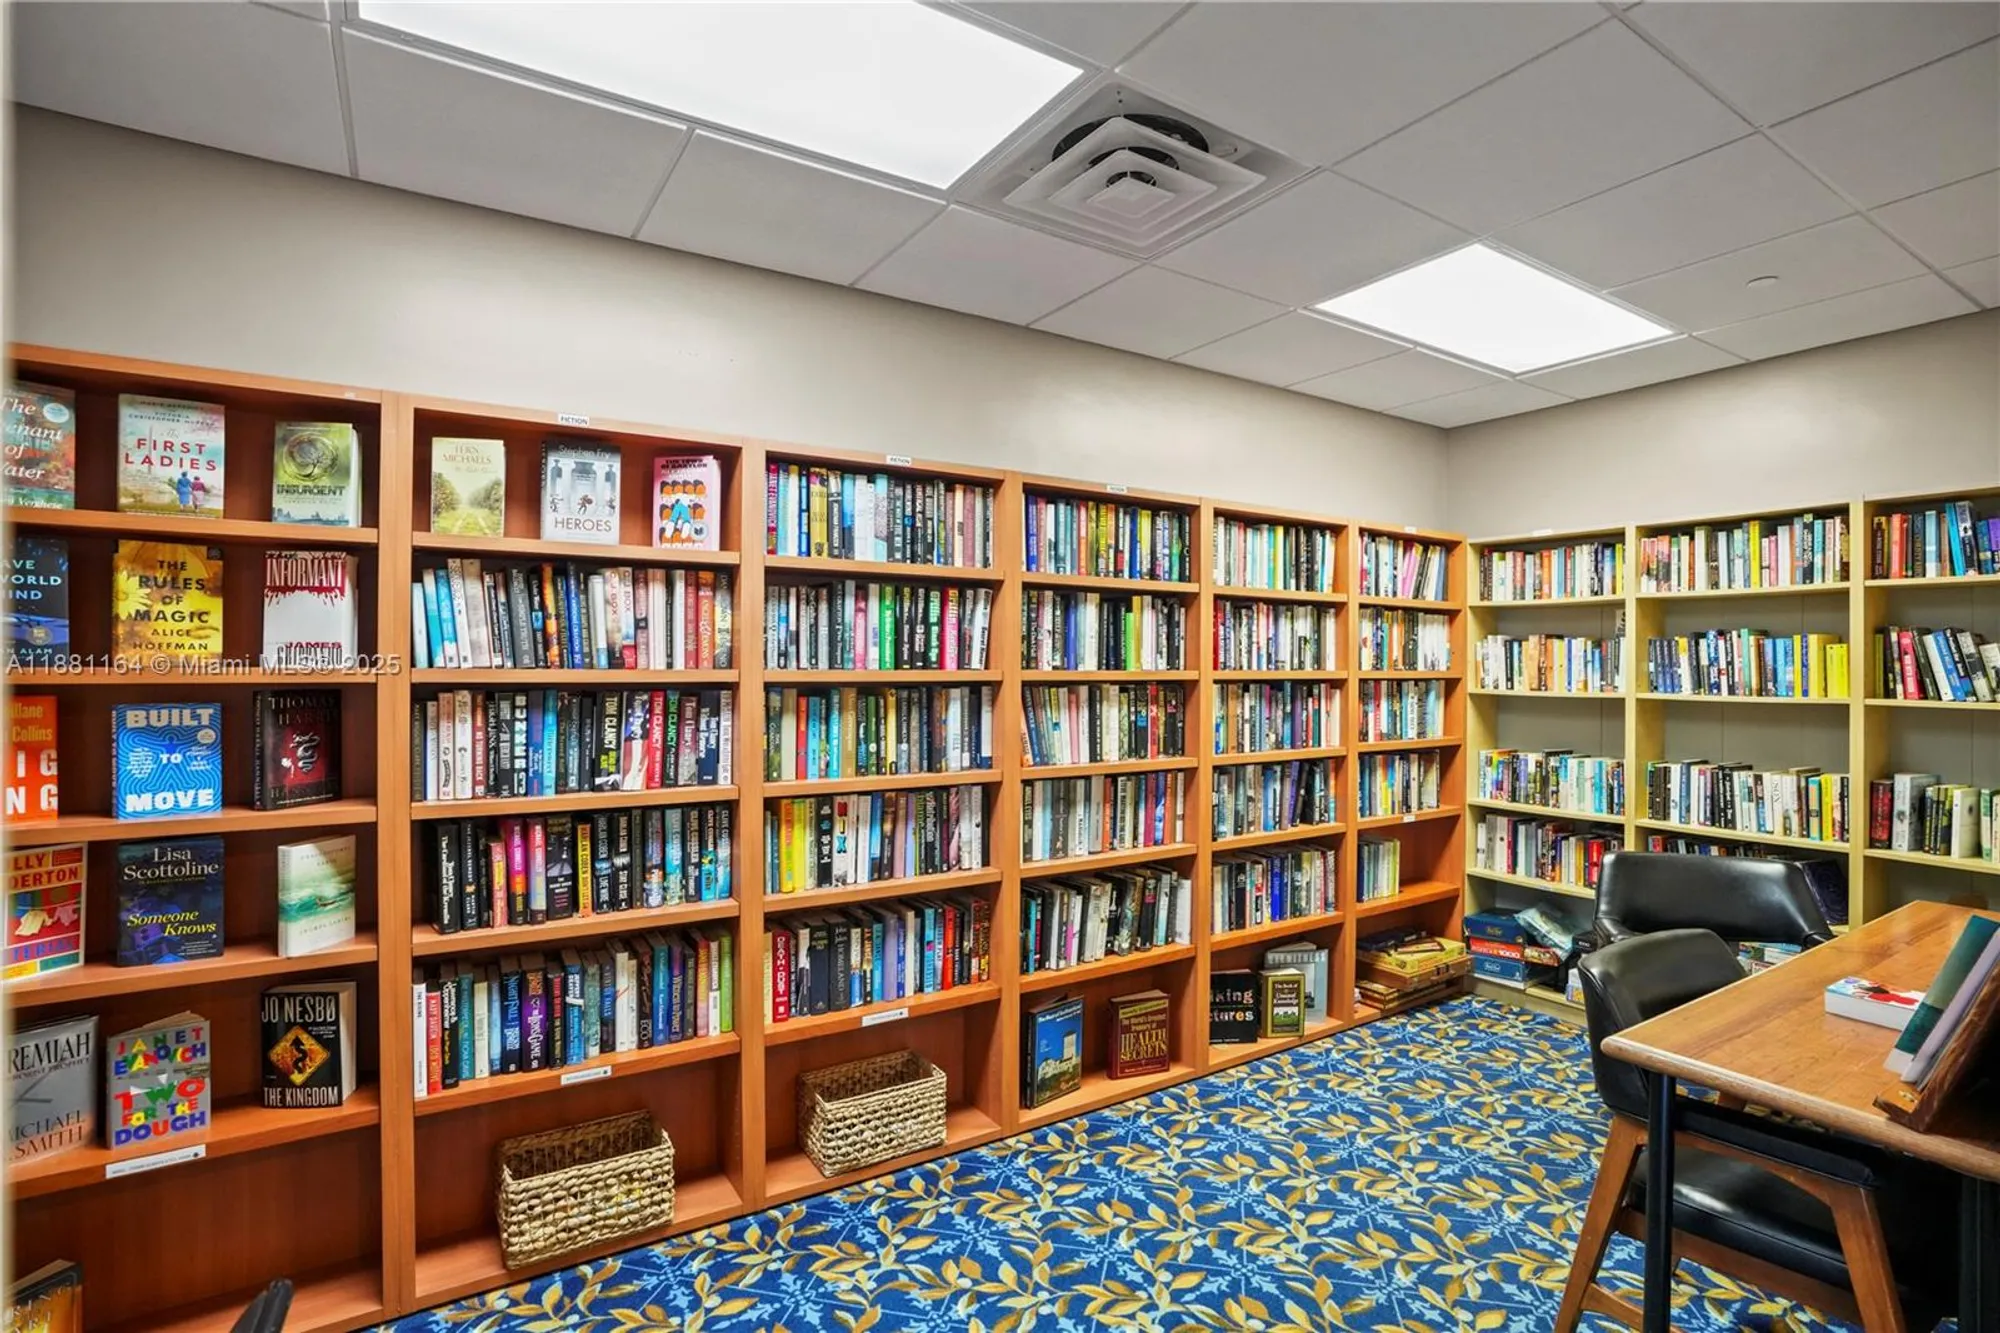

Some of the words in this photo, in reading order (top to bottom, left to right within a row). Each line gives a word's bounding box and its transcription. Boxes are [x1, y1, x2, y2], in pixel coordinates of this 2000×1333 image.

[560, 415, 588, 425] FICTION
[136, 438, 206, 455] FIRST
[558, 444, 594, 458] Stephen
[596, 448, 612, 460] Fry
[2, 462, 45, 480] ater
[124, 452, 218, 471] LADIES
[276, 483, 346, 496] INSURGENT
[554, 517, 612, 533] HEROES
[157, 560, 188, 571] THE
[266, 557, 343, 588] INFORMANT
[138, 575, 205, 590] RULES
[161, 595, 184, 605] OF
[133, 608, 211, 623] MAGIC
[151, 628, 192, 637] ALICE
[133, 642, 208, 651] HOFFMAN
[284, 641, 342, 649] JAMES
[604, 697, 618, 715] TOM
[653, 697, 663, 714] TOM
[126, 708, 214, 729] BUILT
[709, 717, 719, 729] Tom
[12, 726, 53, 742] Collins
[604, 717, 618, 749] CLANCY
[653, 715, 663, 749] CLANCY
[668, 714, 678, 748] CLANCY
[708, 729, 719, 750] Clancy
[160, 753, 183, 764] TO
[126, 787, 214, 813] MOVE
[598, 817, 608, 839] HARLAN
[690, 811, 699, 832] CLIVE
[721, 810, 730, 829] CLIVE
[580, 826, 590, 853] HARLAN
[599, 839, 609, 859] COBEN
[690, 832, 699, 863] CUSSLER
[154, 847, 192, 862] Lisa
[581, 853, 590, 875] COBEN
[123, 863, 220, 881] Scottoline
[600, 876, 609, 887] LIVE
[600, 887, 609, 902] WIRE
[126, 910, 200, 928] Someone
[163, 922, 218, 937] Knows
[1499, 950, 1520, 959] 1000
[837, 943, 845, 991] HOMELAND
[443, 981, 454, 1029] Oppenheimer
[449, 982, 458, 1016] Lawrence
[262, 997, 279, 1023] JO
[284, 996, 337, 1023] NESBØ
[504, 1000, 519, 1020] FALL
[640, 1019, 651, 1040] ECO
[117, 1027, 204, 1056] JANET
[527, 1034, 544, 1060] GAME
[1121, 1028, 1167, 1053] HEALTH
[114, 1041, 207, 1076] EVANOVICH
[1120, 1040, 1169, 1062] SECRETS
[114, 1077, 206, 1111] TWO
[264, 1087, 284, 1107] THE
[285, 1086, 339, 1107] KINGDOM
[121, 1107, 158, 1128] FOR
[167, 1097, 199, 1117] THE
[114, 1111, 206, 1147] DOUGH
[14, 1125, 83, 1160] SMITH
